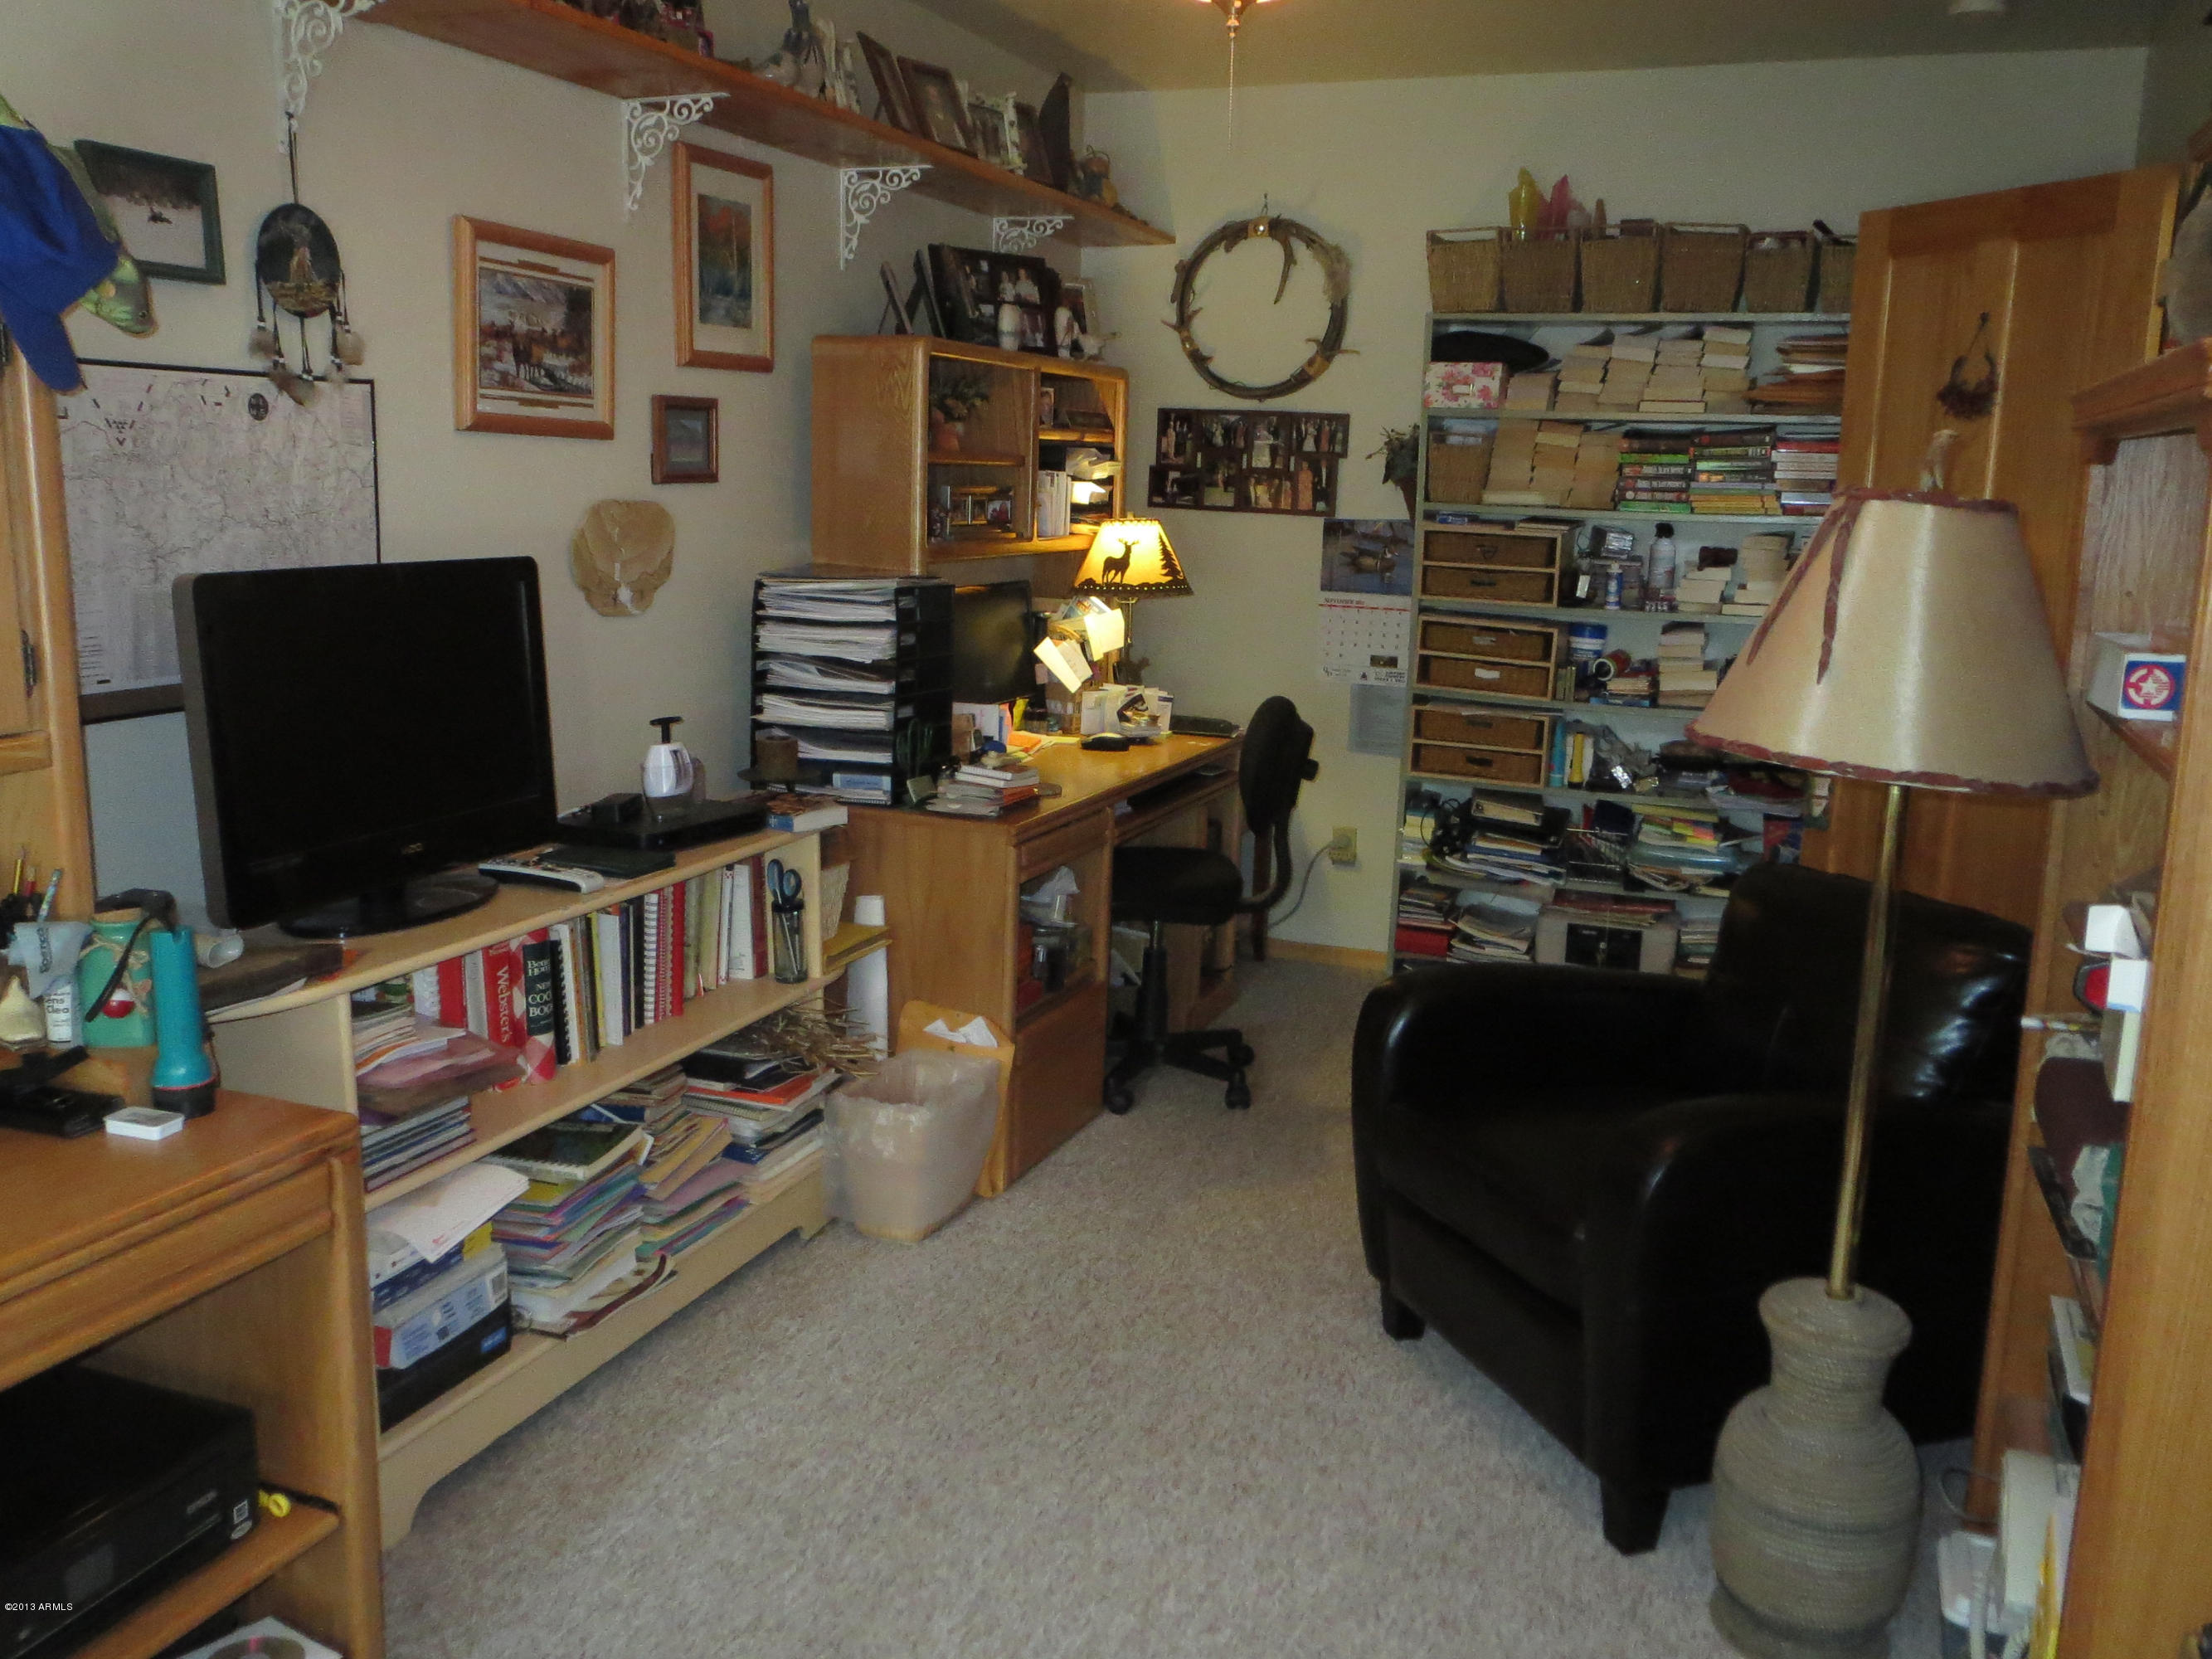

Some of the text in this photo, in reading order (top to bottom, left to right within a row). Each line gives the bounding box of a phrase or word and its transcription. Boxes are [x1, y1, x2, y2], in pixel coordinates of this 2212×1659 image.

[46, 995, 65, 1005] ens
[497, 966, 512, 1043] Webster's
[528, 991, 552, 1005] COO
[529, 1004, 553, 1017] BOO
